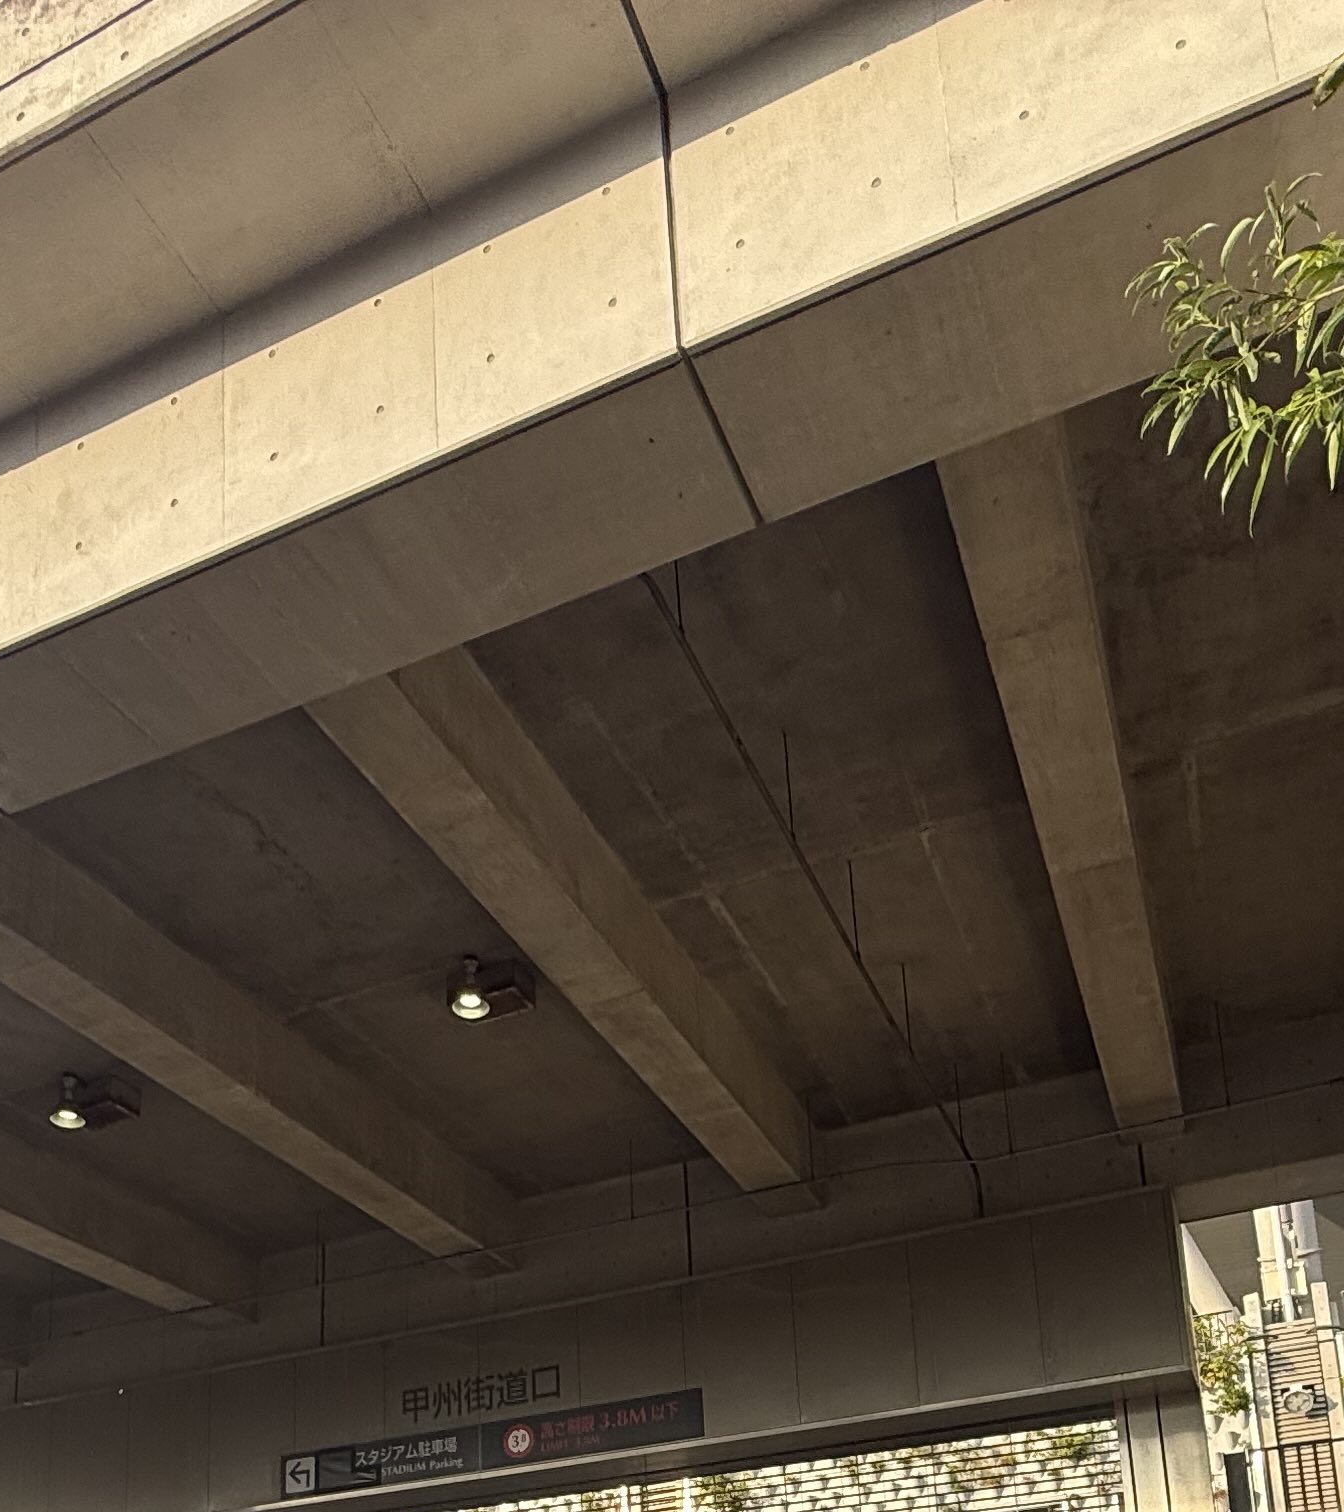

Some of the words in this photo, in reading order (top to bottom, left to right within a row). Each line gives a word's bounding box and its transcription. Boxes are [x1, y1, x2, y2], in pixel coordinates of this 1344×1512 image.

[402, 1365, 560, 1424] 甲州街道口
[355, 1436, 457, 1468] スタジアム駐車場
[381, 1464, 426, 1477] STADIUM
[429, 1457, 464, 1470] Parking
